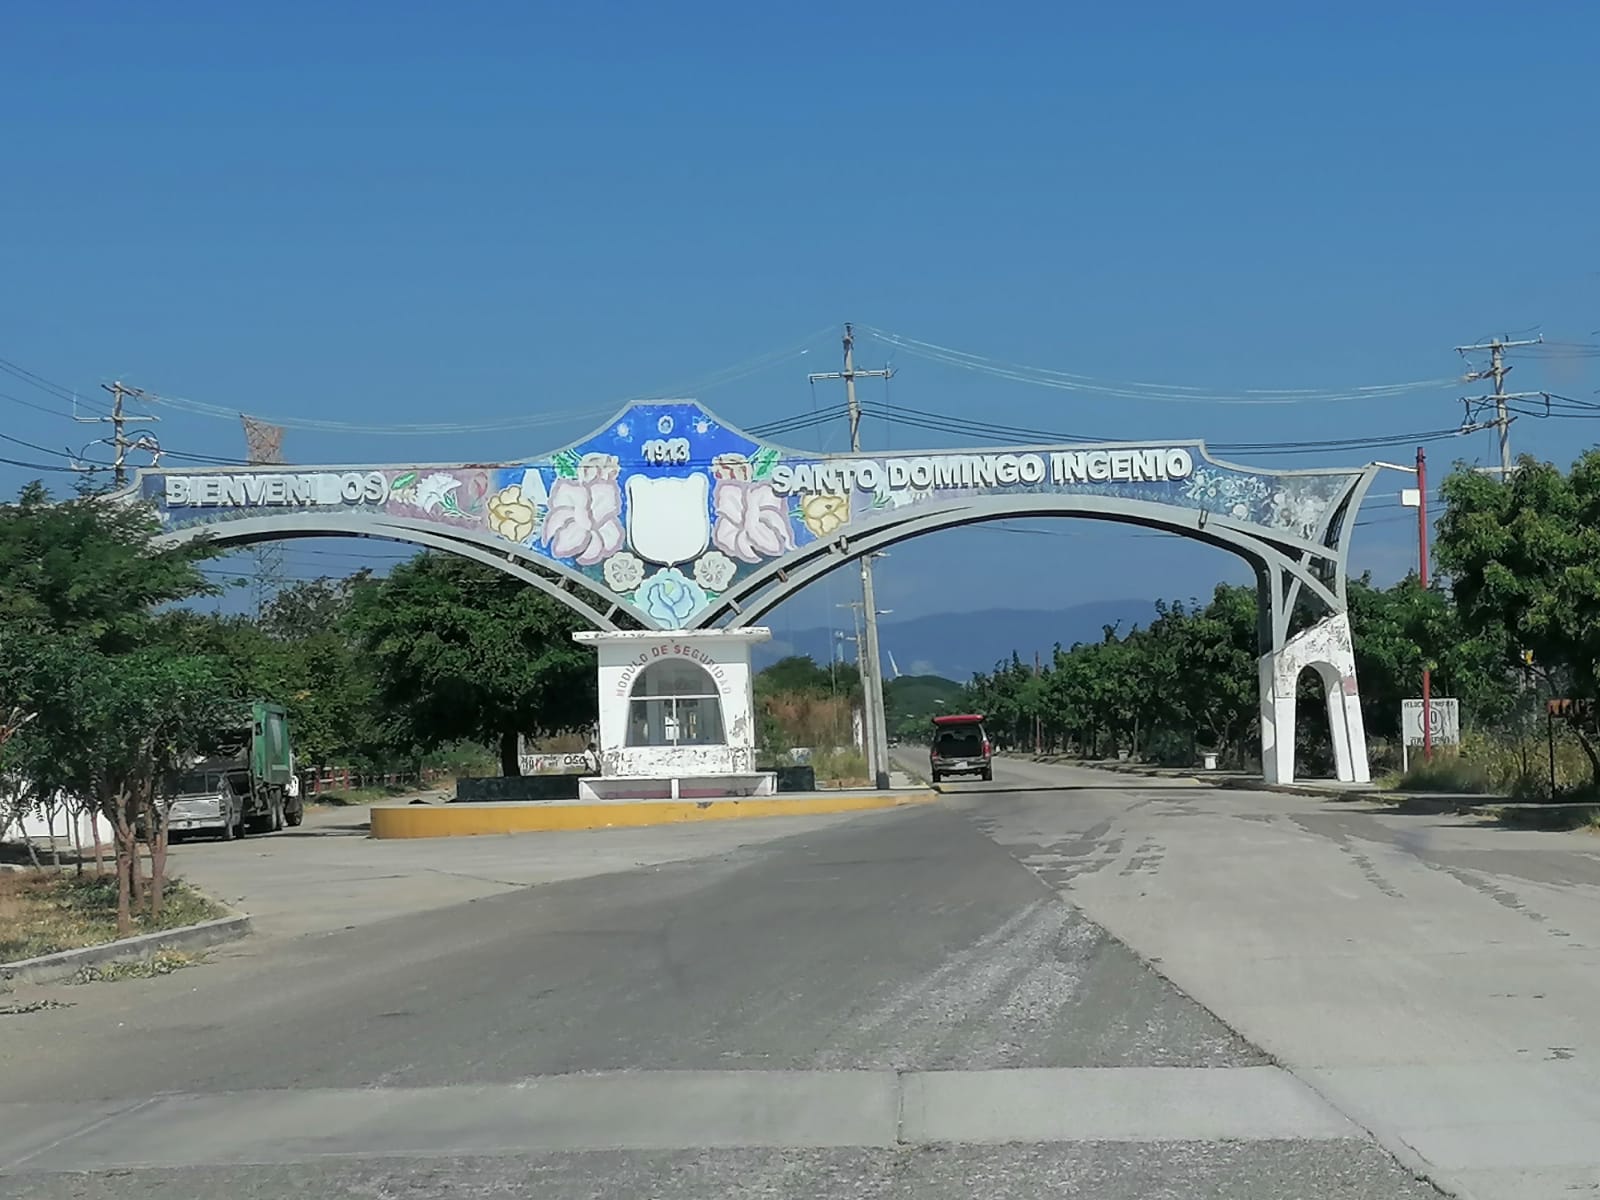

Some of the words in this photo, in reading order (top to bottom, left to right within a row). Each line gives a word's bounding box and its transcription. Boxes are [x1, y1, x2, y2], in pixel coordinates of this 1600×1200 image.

[642, 438, 690, 466] 1913
[771, 460, 880, 497] SANTO
[885, 452, 1046, 492] DOMINGO
[1050, 448, 1193, 485] INGENIO
[651, 644, 668, 657] DE
